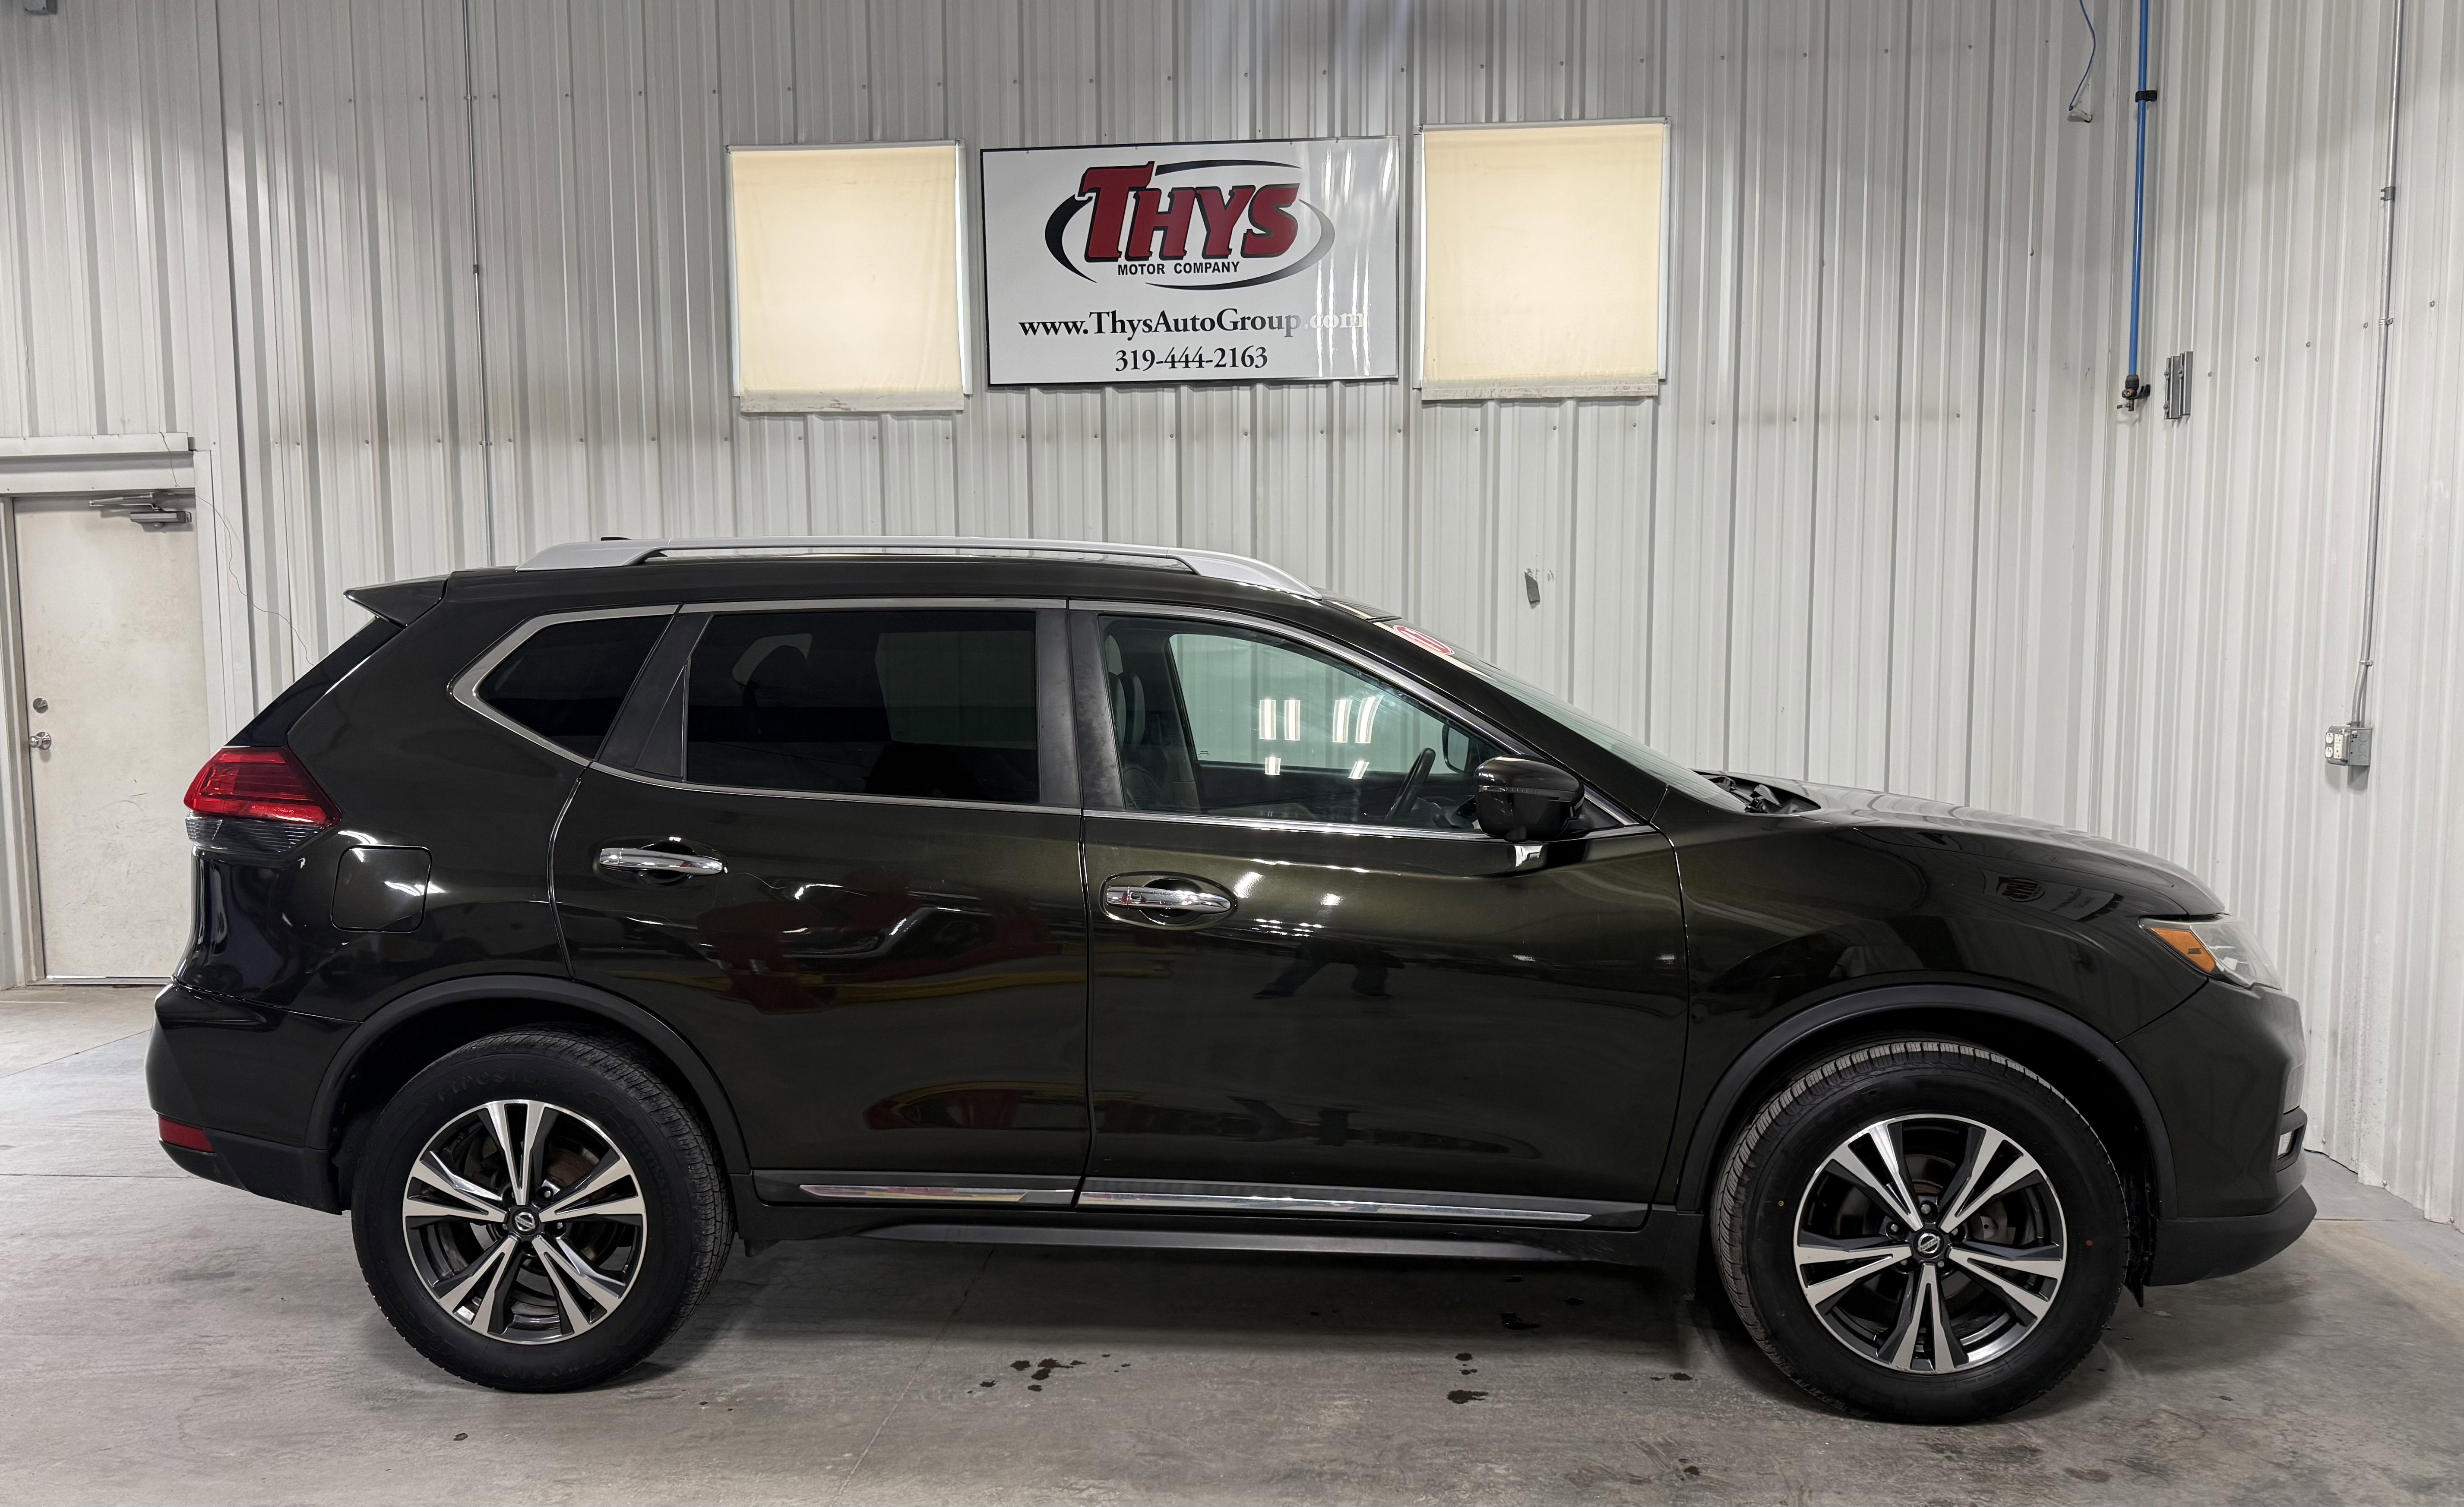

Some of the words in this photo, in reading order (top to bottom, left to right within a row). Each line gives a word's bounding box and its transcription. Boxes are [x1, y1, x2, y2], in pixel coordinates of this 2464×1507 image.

[1078, 161, 1300, 262] THYS
[1118, 263, 1165, 275] MOTOR
[1174, 261, 1240, 274] COMPANY
[1018, 308, 1364, 341] www.ThysAutoGroup.com
[1115, 346, 1268, 372] 319-444-2163
